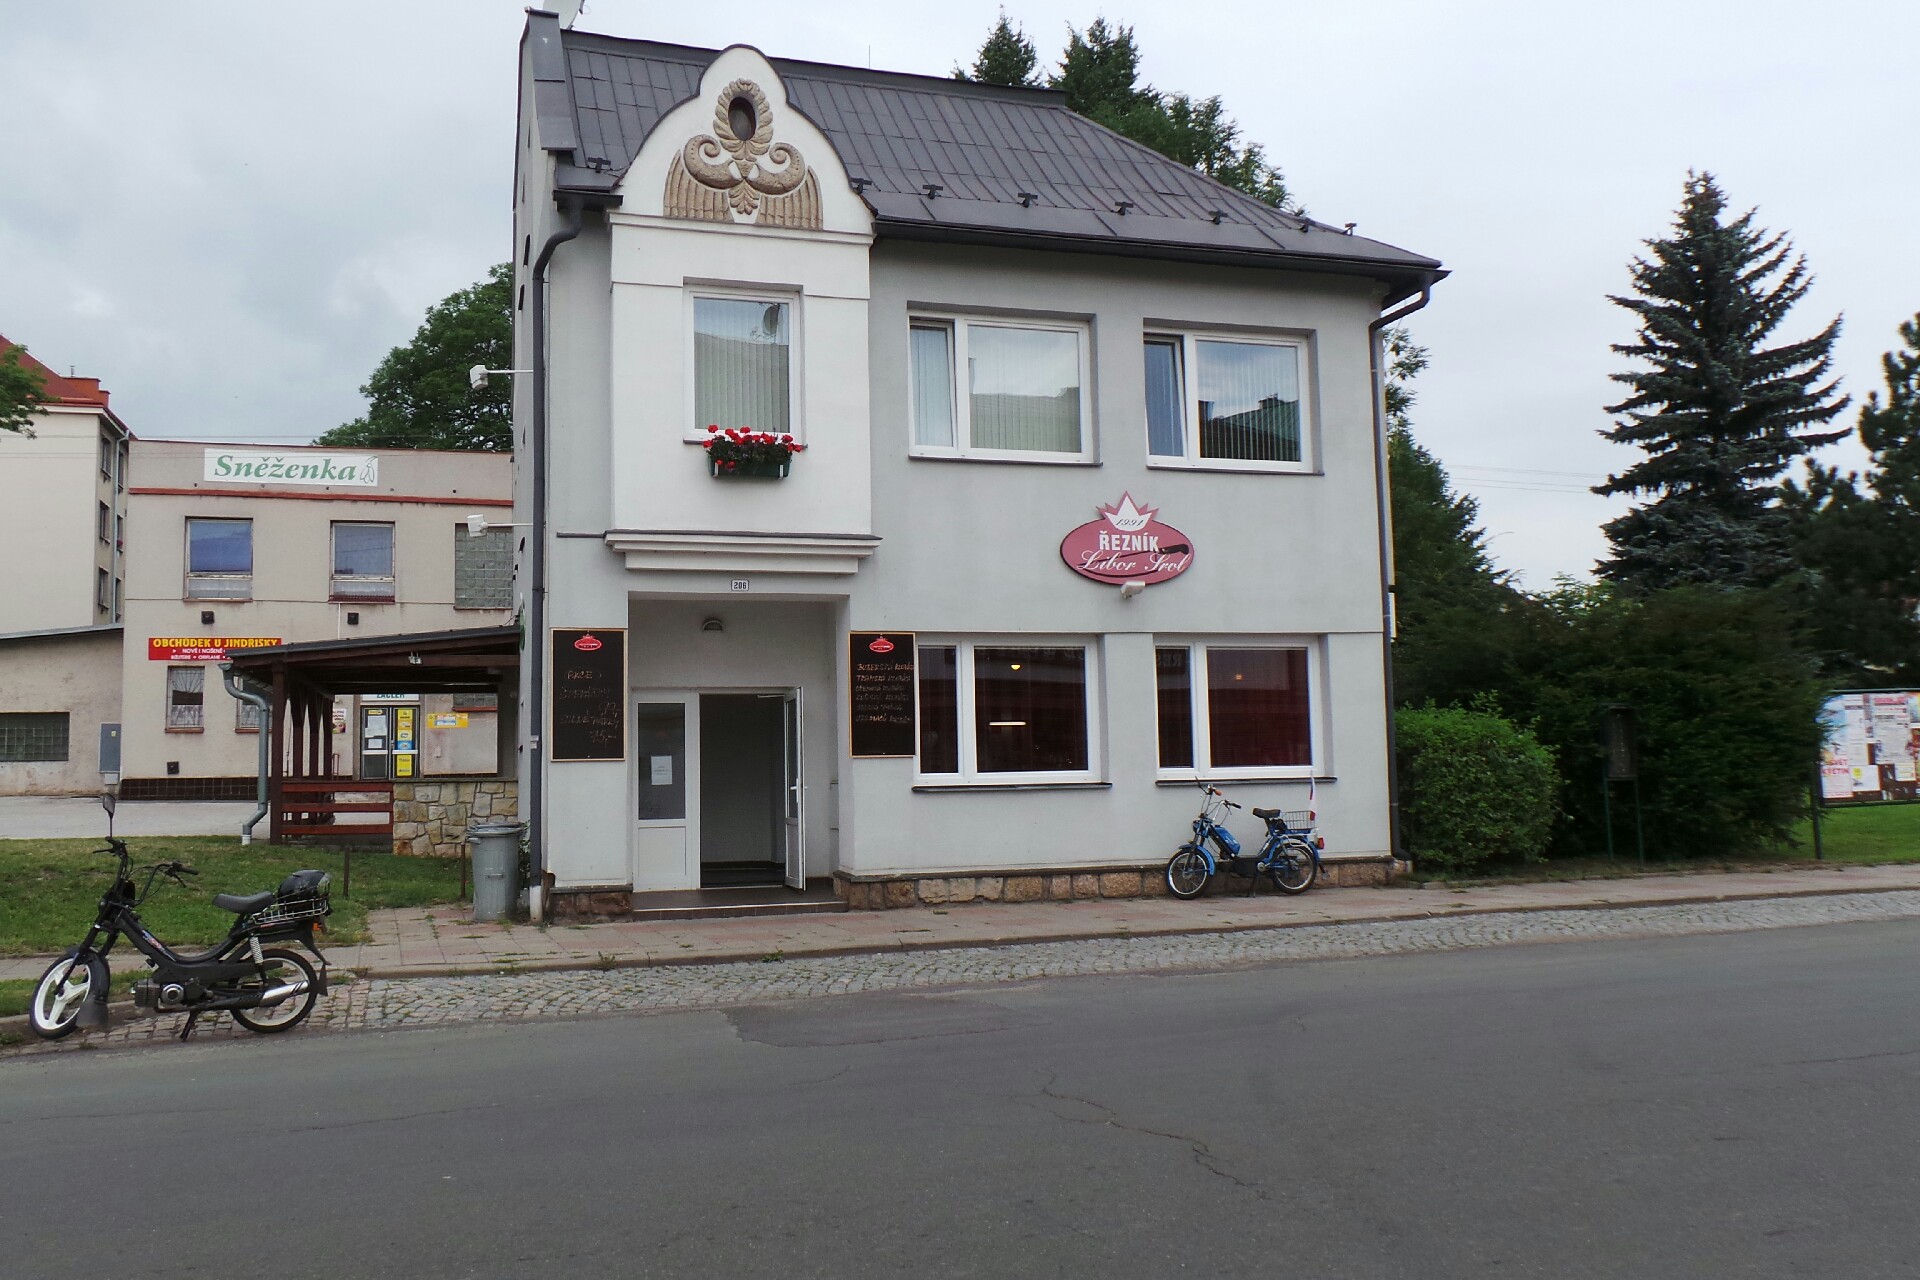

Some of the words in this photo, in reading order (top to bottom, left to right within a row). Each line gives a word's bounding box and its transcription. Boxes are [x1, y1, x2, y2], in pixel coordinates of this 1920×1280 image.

[214, 454, 357, 481] Sněženka
[1115, 518, 1144, 526] 1991
[1099, 530, 1159, 552] ŘEZNÍK
[1077, 550, 1136, 571] Libor
[733, 581, 747, 590] 206
[214, 638, 222, 648] U
